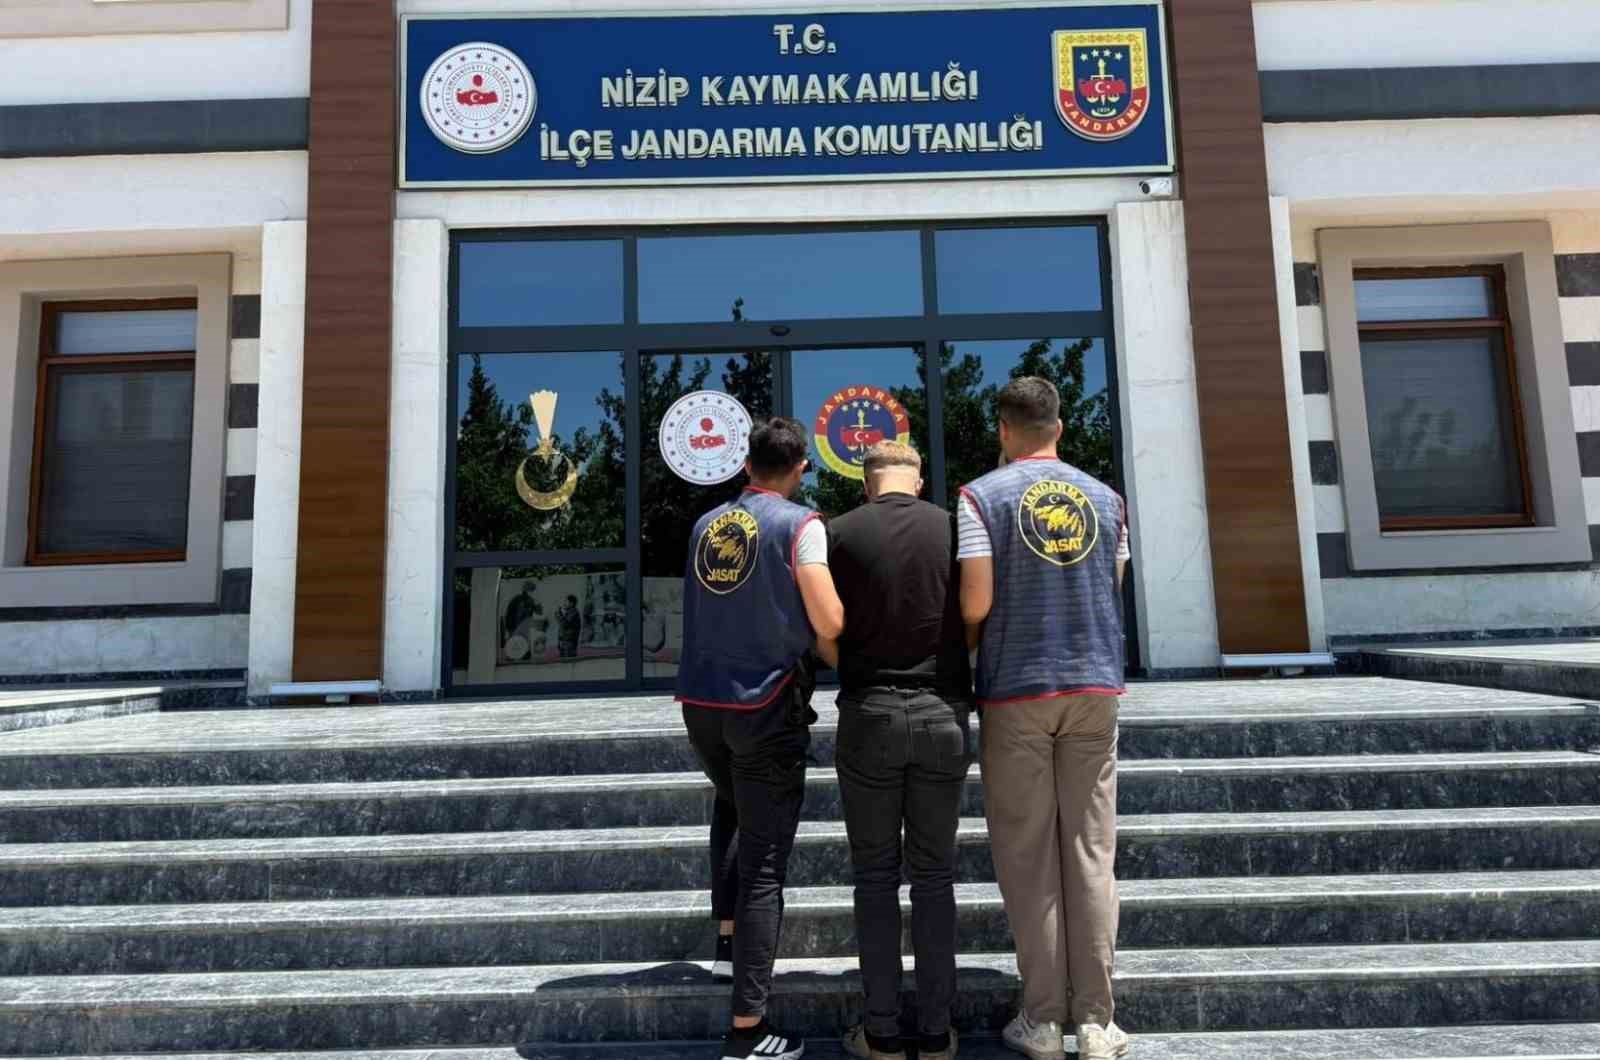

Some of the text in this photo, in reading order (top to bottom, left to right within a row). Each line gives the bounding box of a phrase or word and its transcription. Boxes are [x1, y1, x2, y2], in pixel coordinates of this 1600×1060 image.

[774, 23, 837, 54] T.C.
[601, 61, 978, 107] NİZİP KAYMAKAMLIĞI
[1063, 98, 1143, 132] JANDARMA
[540, 113, 1044, 168] İLÇE JANDARMA KOMUTANLIĞI
[818, 387, 904, 424] JANDARMA
[1024, 481, 1088, 509] JANDARMA
[1044, 537, 1083, 553] JASAT
[706, 568, 740, 582] JASAT
